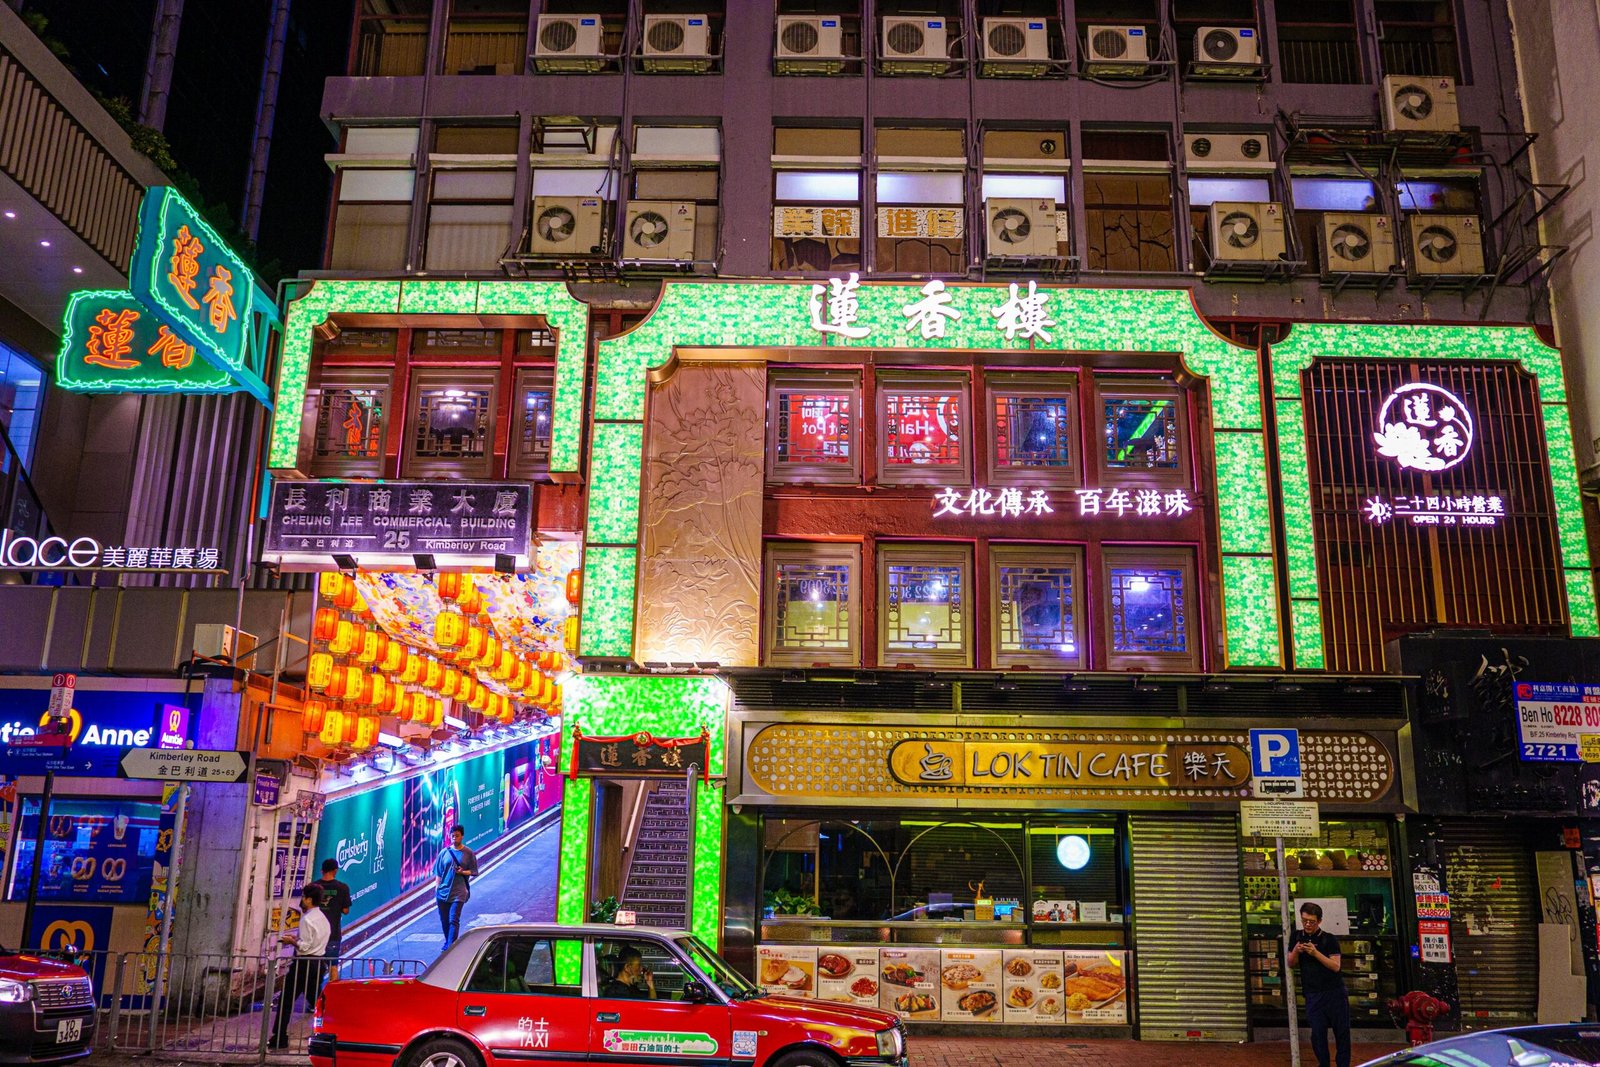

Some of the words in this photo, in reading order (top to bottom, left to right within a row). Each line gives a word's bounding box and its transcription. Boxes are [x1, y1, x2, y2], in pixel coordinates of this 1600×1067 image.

[168, 225, 236, 333] 蓮香
[809, 272, 1057, 343] 蓮香樓
[284, 488, 518, 514] 長利商業大廈
[933, 487, 1054, 518] 文化傳承
[1075, 488, 1193, 518] 百年滋味
[1395, 496, 1504, 513] 二十四小時營業
[282, 515, 331, 526] CHEUNG
[341, 515, 363, 526] LEE
[373, 517, 451, 528] COMMERCIAL
[461, 518, 516, 529] BUILDING
[1413, 515, 1439, 525] OPEN
[1444, 515, 1456, 525] 24
[1462, 515, 1496, 526] HOURS
[384, 531, 410, 549] 25
[425, 540, 475, 552] Kimberley
[480, 540, 506, 551] Road
[102, 546, 219, 569] 美麗華廣場
[1521, 706, 1539, 722] Ben
[1540, 706, 1553, 723] Ho
[1553, 705, 1582, 727] 8228
[161, 732, 184, 746] Auntie
[1546, 731, 1567, 739] Kimberley
[149, 752, 193, 763] Kimberley
[197, 753, 220, 763] Road
[1258, 734, 1290, 773] P
[1524, 744, 1567, 757] 2721
[158, 765, 208, 777] 金巴利道
[972, 750, 1032, 778] LOK
[1040, 751, 1082, 780] TIN
[1088, 750, 1171, 779] CAFE
[1184, 751, 1236, 780] 樂天
[336, 832, 369, 872] Carlsberg
[373, 858, 385, 874] LFC
[518, 1016, 549, 1032] 的士
[58, 1029, 79, 1043] 3499
[519, 1032, 549, 1048] TAXI
